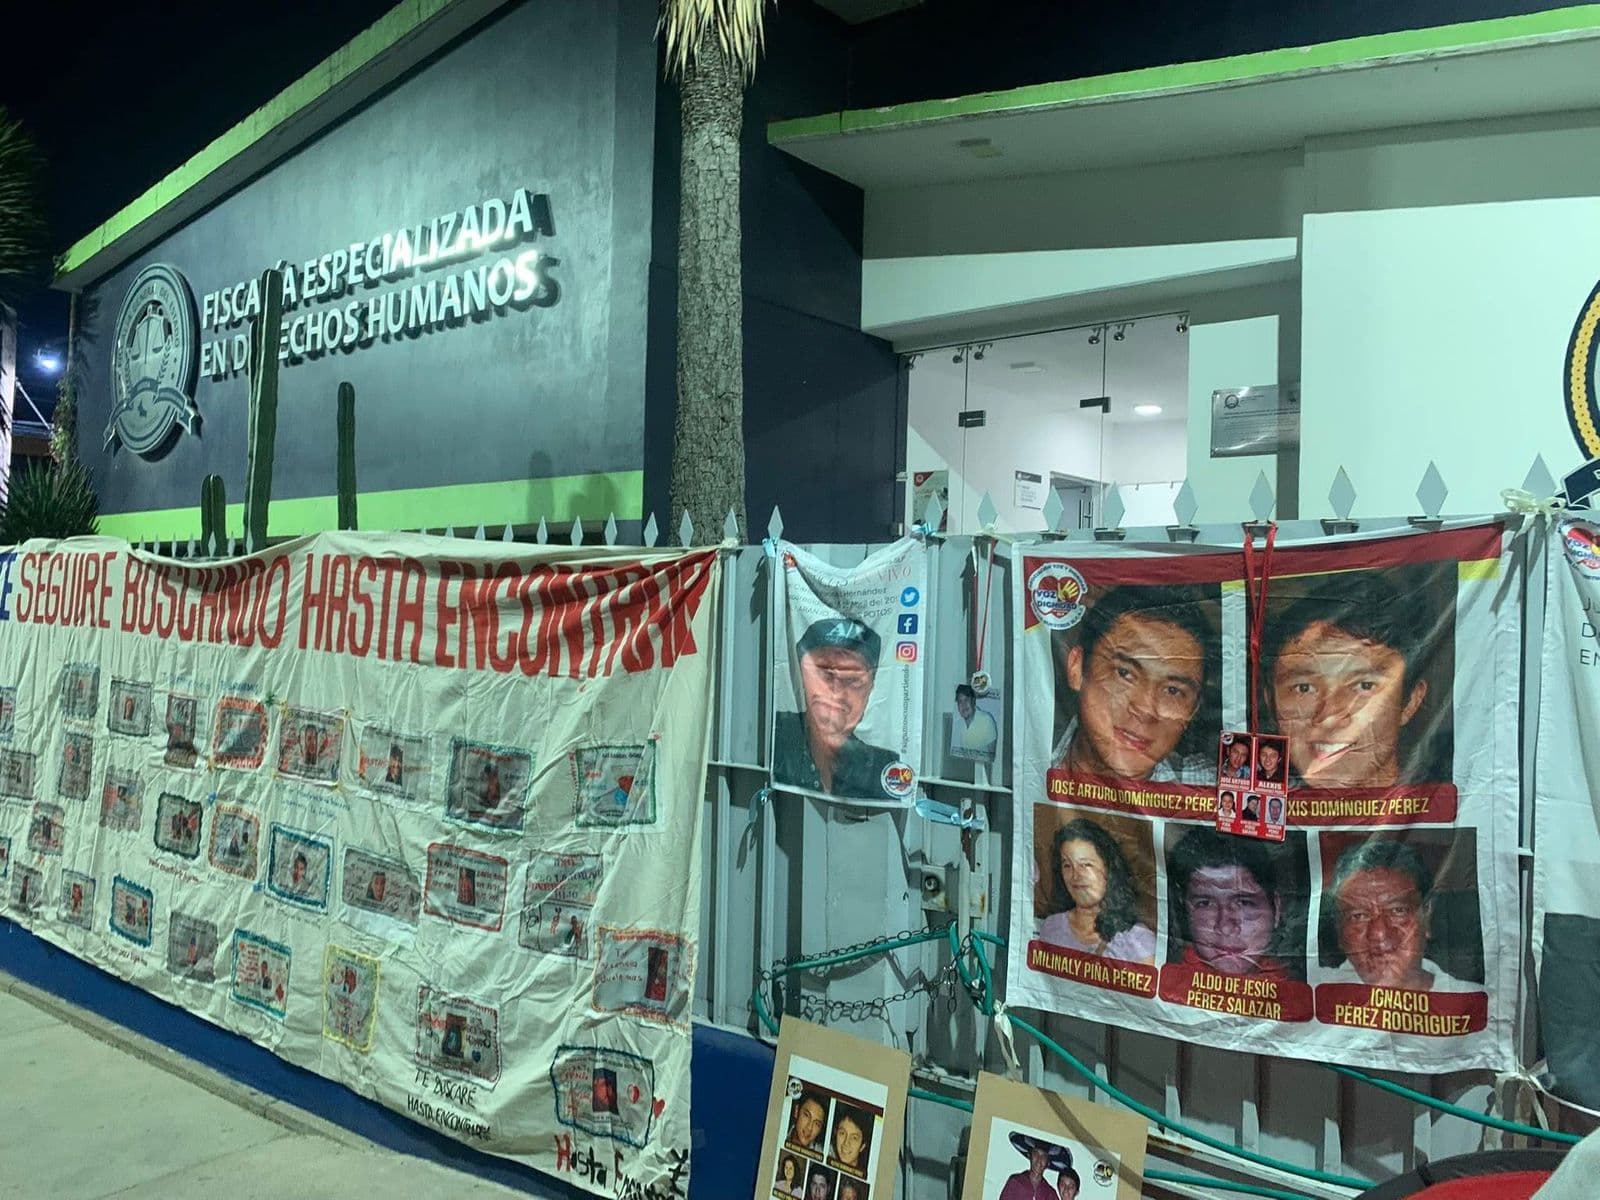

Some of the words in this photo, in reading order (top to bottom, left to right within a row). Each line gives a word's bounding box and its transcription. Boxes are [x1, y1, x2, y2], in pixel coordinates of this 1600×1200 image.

[202, 259, 298, 329] FISCAA
[303, 187, 534, 299] ESPECIALIZADA
[200, 338, 227, 377] EN
[233, 301, 360, 371] DECHOS
[367, 249, 539, 338] HUMANOS
[16, 551, 118, 629] SEGUIRE
[121, 552, 291, 649] BUSCANDO
[298, 553, 427, 664] HASTA
[1037, 590, 1057, 599] VOZ
[1037, 600, 1078, 610] DIGNIDAD
[1051, 779, 1075, 795] JOSÉ
[1077, 783, 1120, 802] ARTURO
[1119, 788, 1182, 810] DOMÍNGUEZ
[1287, 801, 1308, 816] XIS
[1311, 797, 1387, 817] DOMÍNGUEZ
[1388, 796, 1430, 815] PÉREZ
[1032, 949, 1082, 978] MILINALY
[1084, 957, 1110, 984] PIÑA
[1113, 967, 1152, 992] PÉREZ
[1191, 971, 1222, 992] ALDO
[1225, 976, 1240, 993] DE
[1242, 976, 1277, 999] JESÚS
[1226, 996, 1281, 1020] SALAZAR
[1370, 987, 1429, 1013] IGNACIO
[1335, 1002, 1378, 1027] PÉREZ
[415, 1068, 431, 1089] TE
[433, 1075, 478, 1111] BUSCARÉ
[407, 1094, 435, 1123] HASTA
[554, 1132, 608, 1190] Hasta
